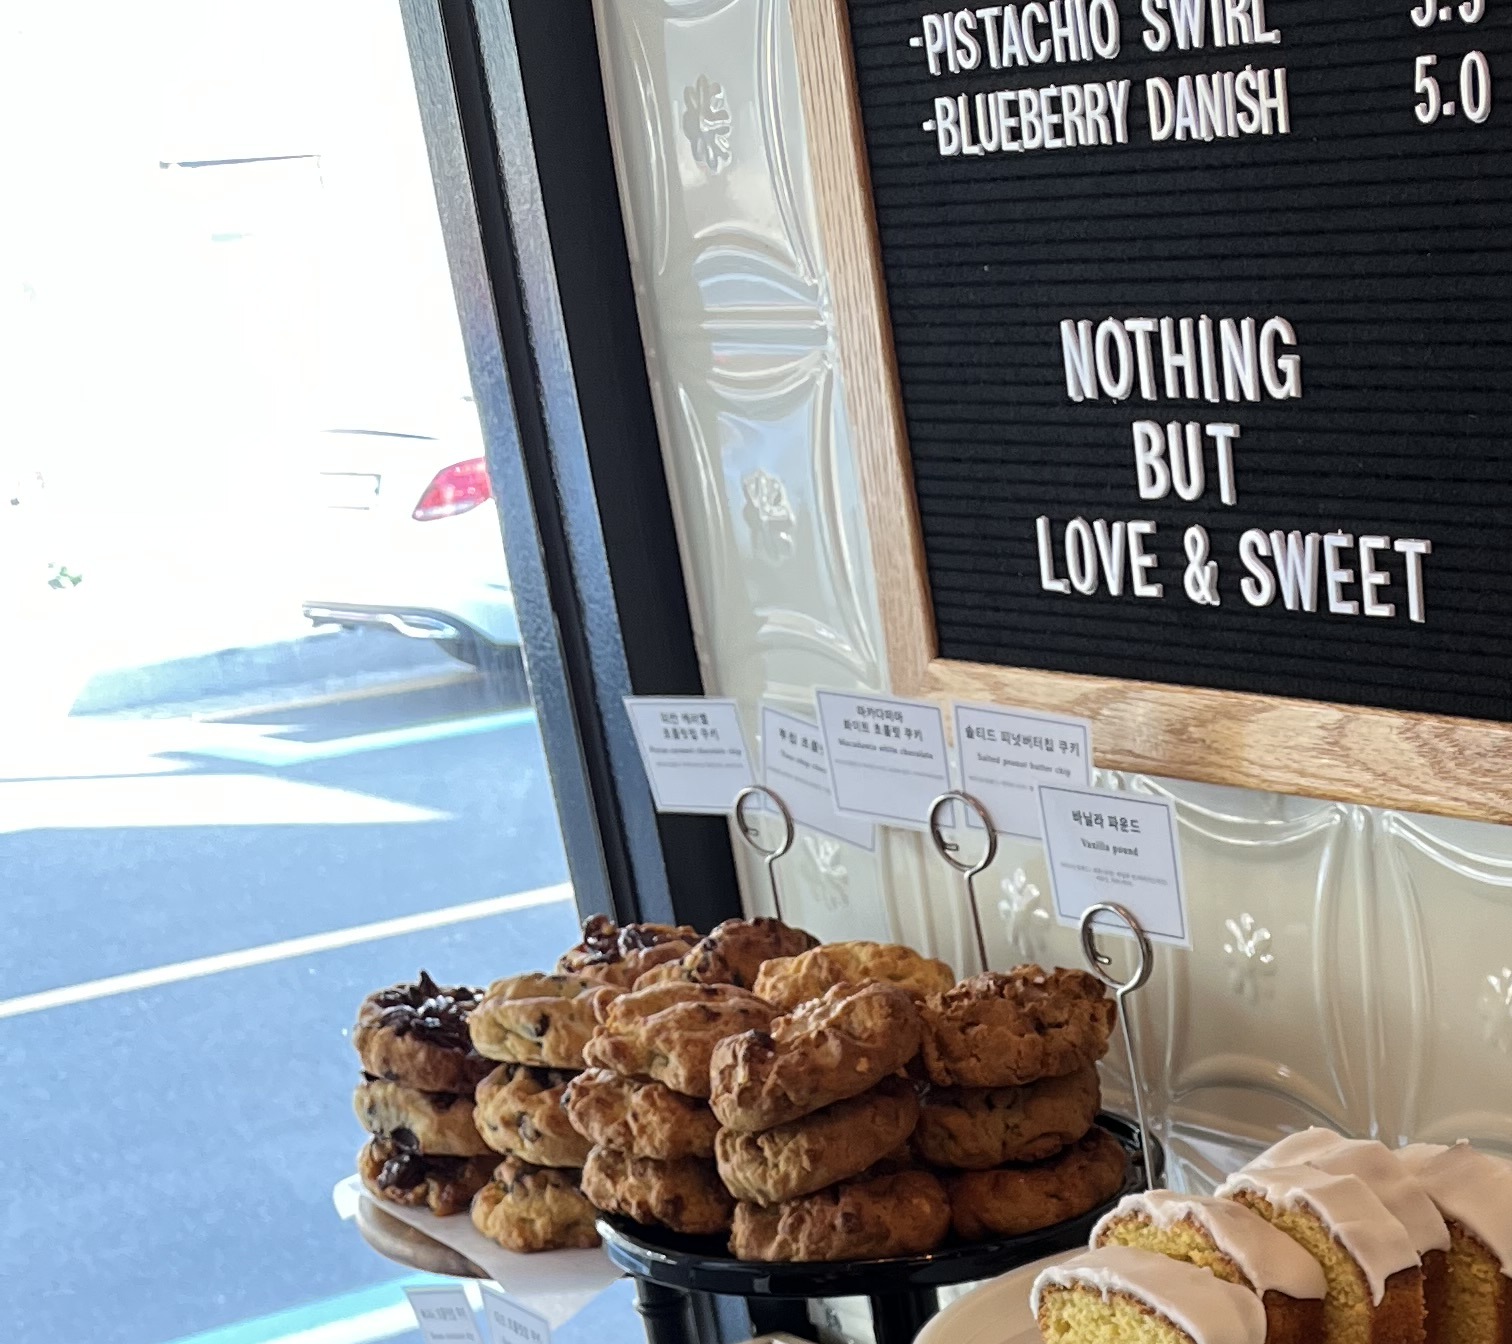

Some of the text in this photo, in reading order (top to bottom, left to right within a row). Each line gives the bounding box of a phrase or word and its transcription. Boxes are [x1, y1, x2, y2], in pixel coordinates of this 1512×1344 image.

[909, 0, 1281, 76] -PISTACHIO SWIRL
[923, 50, 1491, 156] -BLUEBERRY DANISH 5.0
[1060, 316, 1303, 402] NOTHING
[1132, 421, 1241, 506] BUT
[1035, 515, 1432, 624] LOVE & SWEET
[1058, 740, 1079, 756] 쿠키
[1071, 809, 1140, 834] 바닐라 파운드
